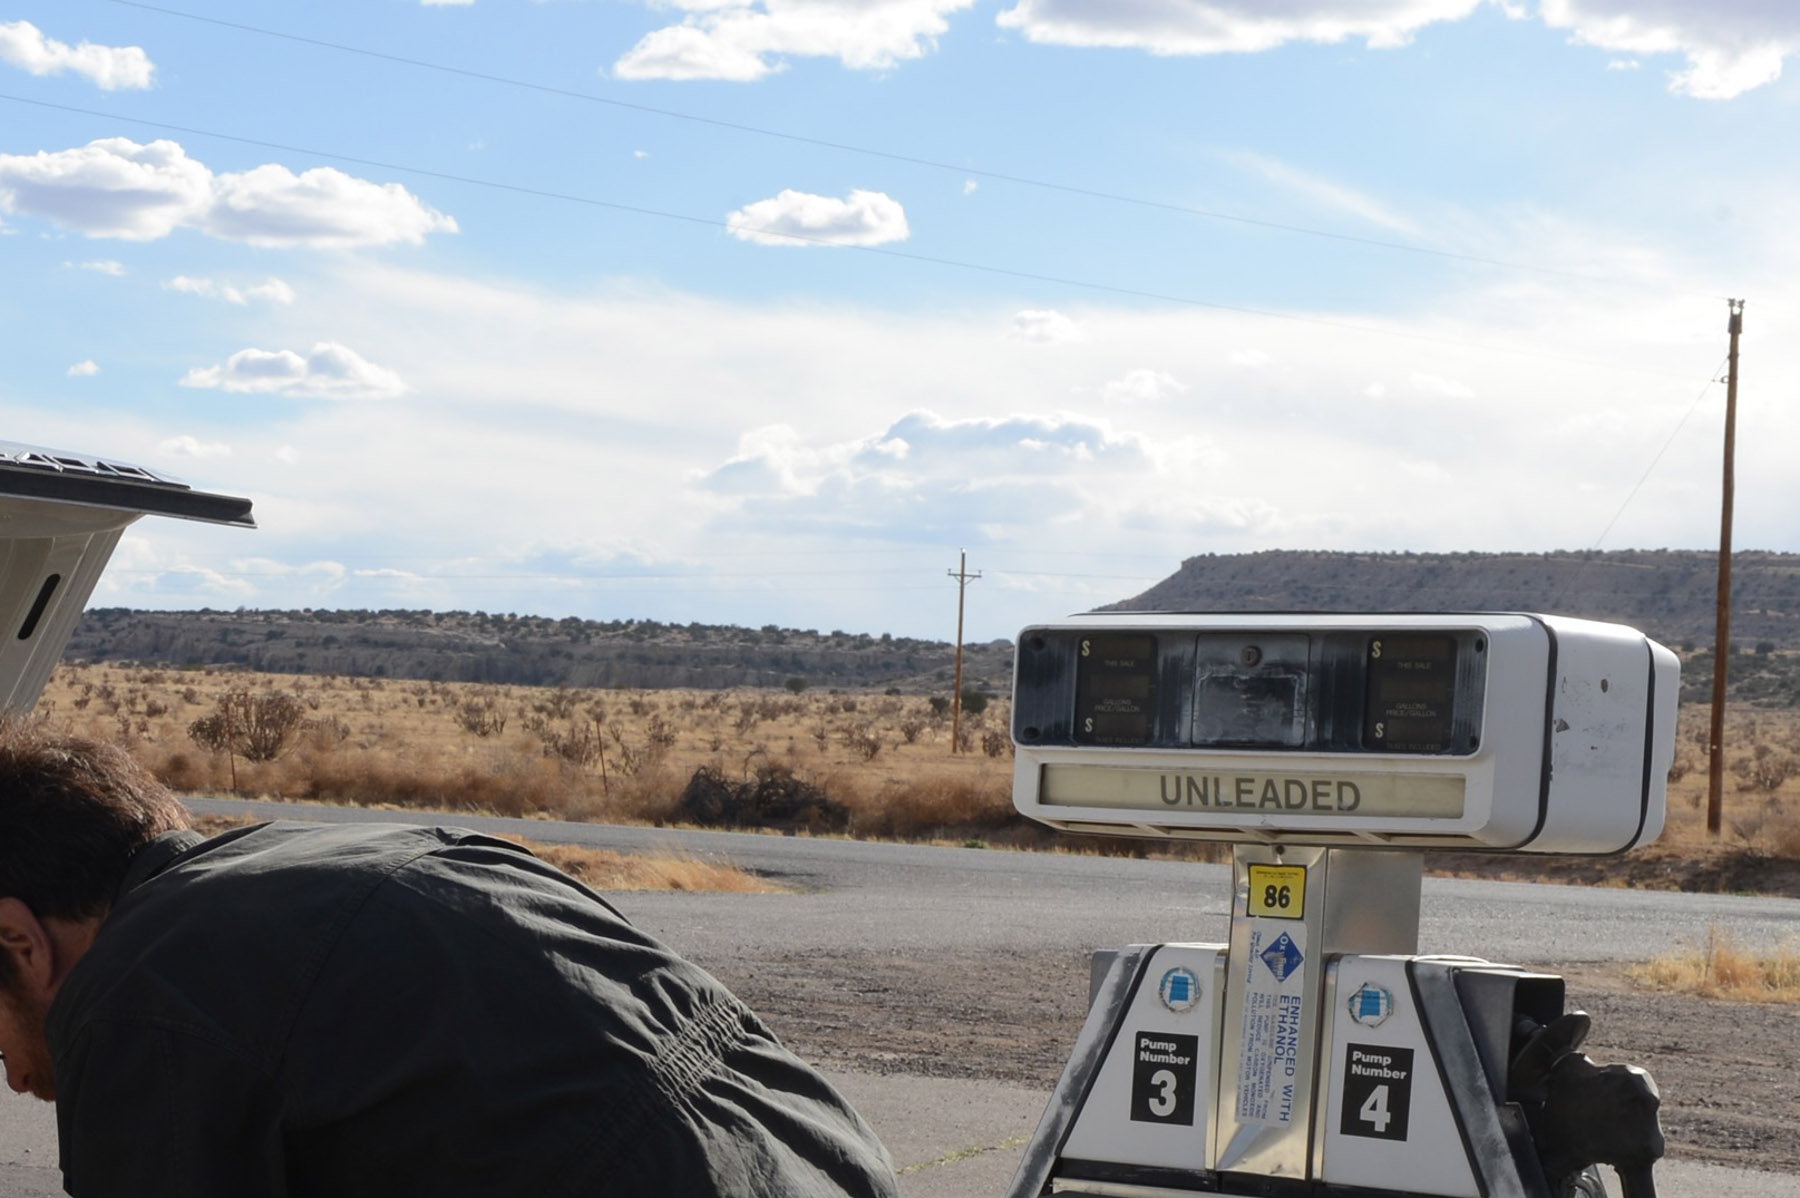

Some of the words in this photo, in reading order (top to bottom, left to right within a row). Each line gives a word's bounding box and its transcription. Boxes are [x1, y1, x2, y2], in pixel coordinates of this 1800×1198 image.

[1160, 775, 1361, 812] UNLEADED
[1264, 885, 1290, 908] 86
[1250, 992, 1258, 1030] POLLUTION
[1141, 1038, 1177, 1052] Pump
[1274, 995, 1290, 1064] ETHANOL
[1285, 996, 1301, 1077] ENHANCED
[1140, 1050, 1190, 1066] Number
[1352, 1050, 1391, 1065] Pump
[1352, 1063, 1407, 1080] Number
[1148, 1069, 1177, 1117] 3
[1279, 1085, 1293, 1121] WITH
[1360, 1085, 1391, 1132] 4
